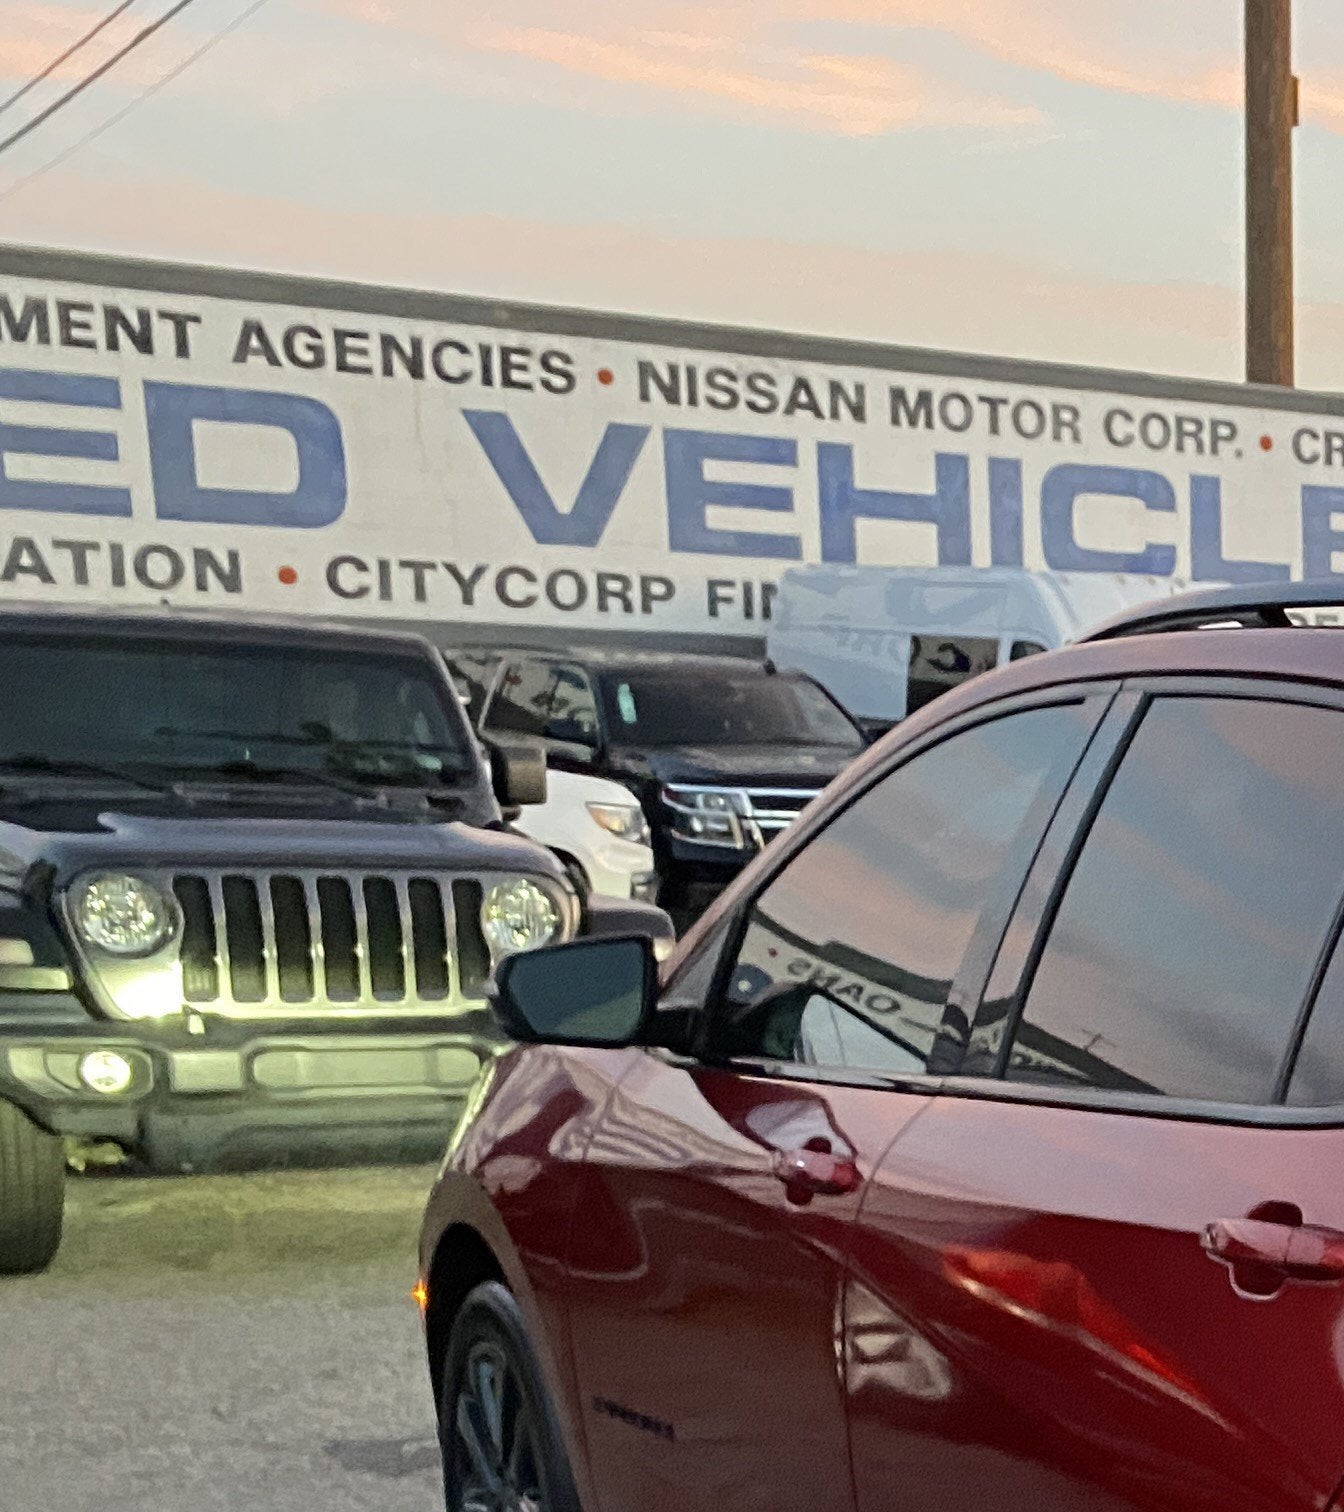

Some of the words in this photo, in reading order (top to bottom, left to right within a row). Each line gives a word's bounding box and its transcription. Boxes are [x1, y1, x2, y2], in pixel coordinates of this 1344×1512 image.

[0, 294, 201, 361] MENT
[232, 319, 577, 395] AGENCIES
[0, 368, 347, 530] ED
[637, 360, 867, 424] NISSAN
[890, 386, 1082, 443] MOTOR
[1104, 410, 1243, 458] CORP.
[1, 536, 243, 594] ATION
[325, 554, 676, 615] CITYCORP
